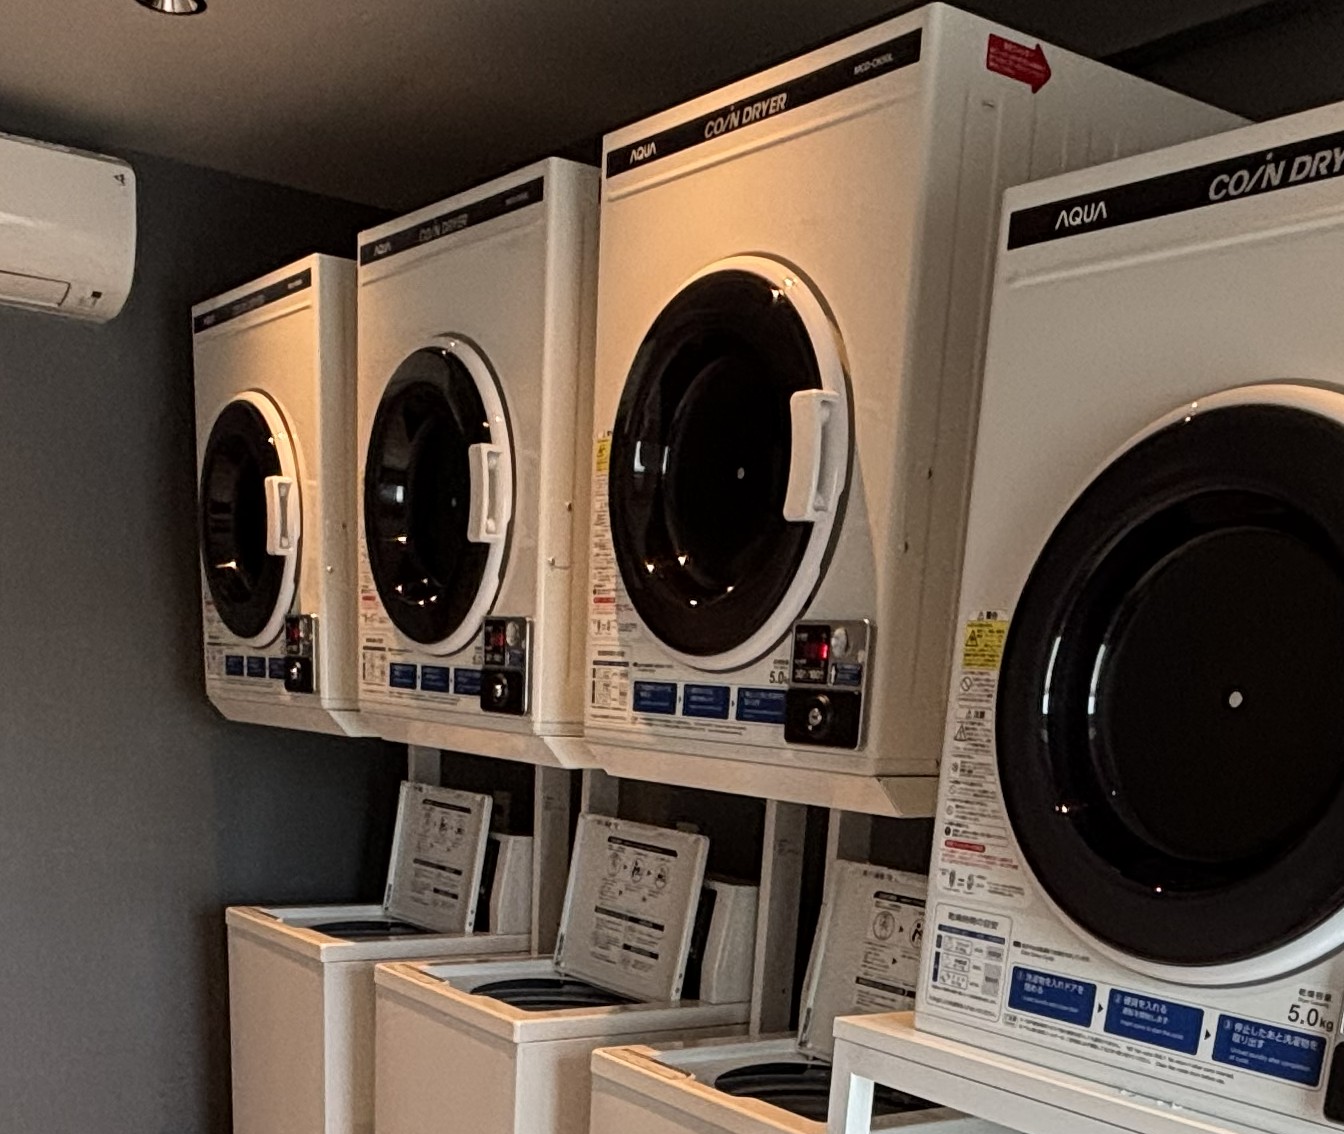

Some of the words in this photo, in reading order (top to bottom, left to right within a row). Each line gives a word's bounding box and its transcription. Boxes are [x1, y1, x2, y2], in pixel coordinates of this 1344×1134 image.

[742, 92, 788, 124] DRYER
[629, 141, 657, 165] AQUA
[1208, 152, 1286, 202] COIN
[1054, 201, 1108, 231] AQUA
[1287, 1003, 1334, 1033] 5.0kg
